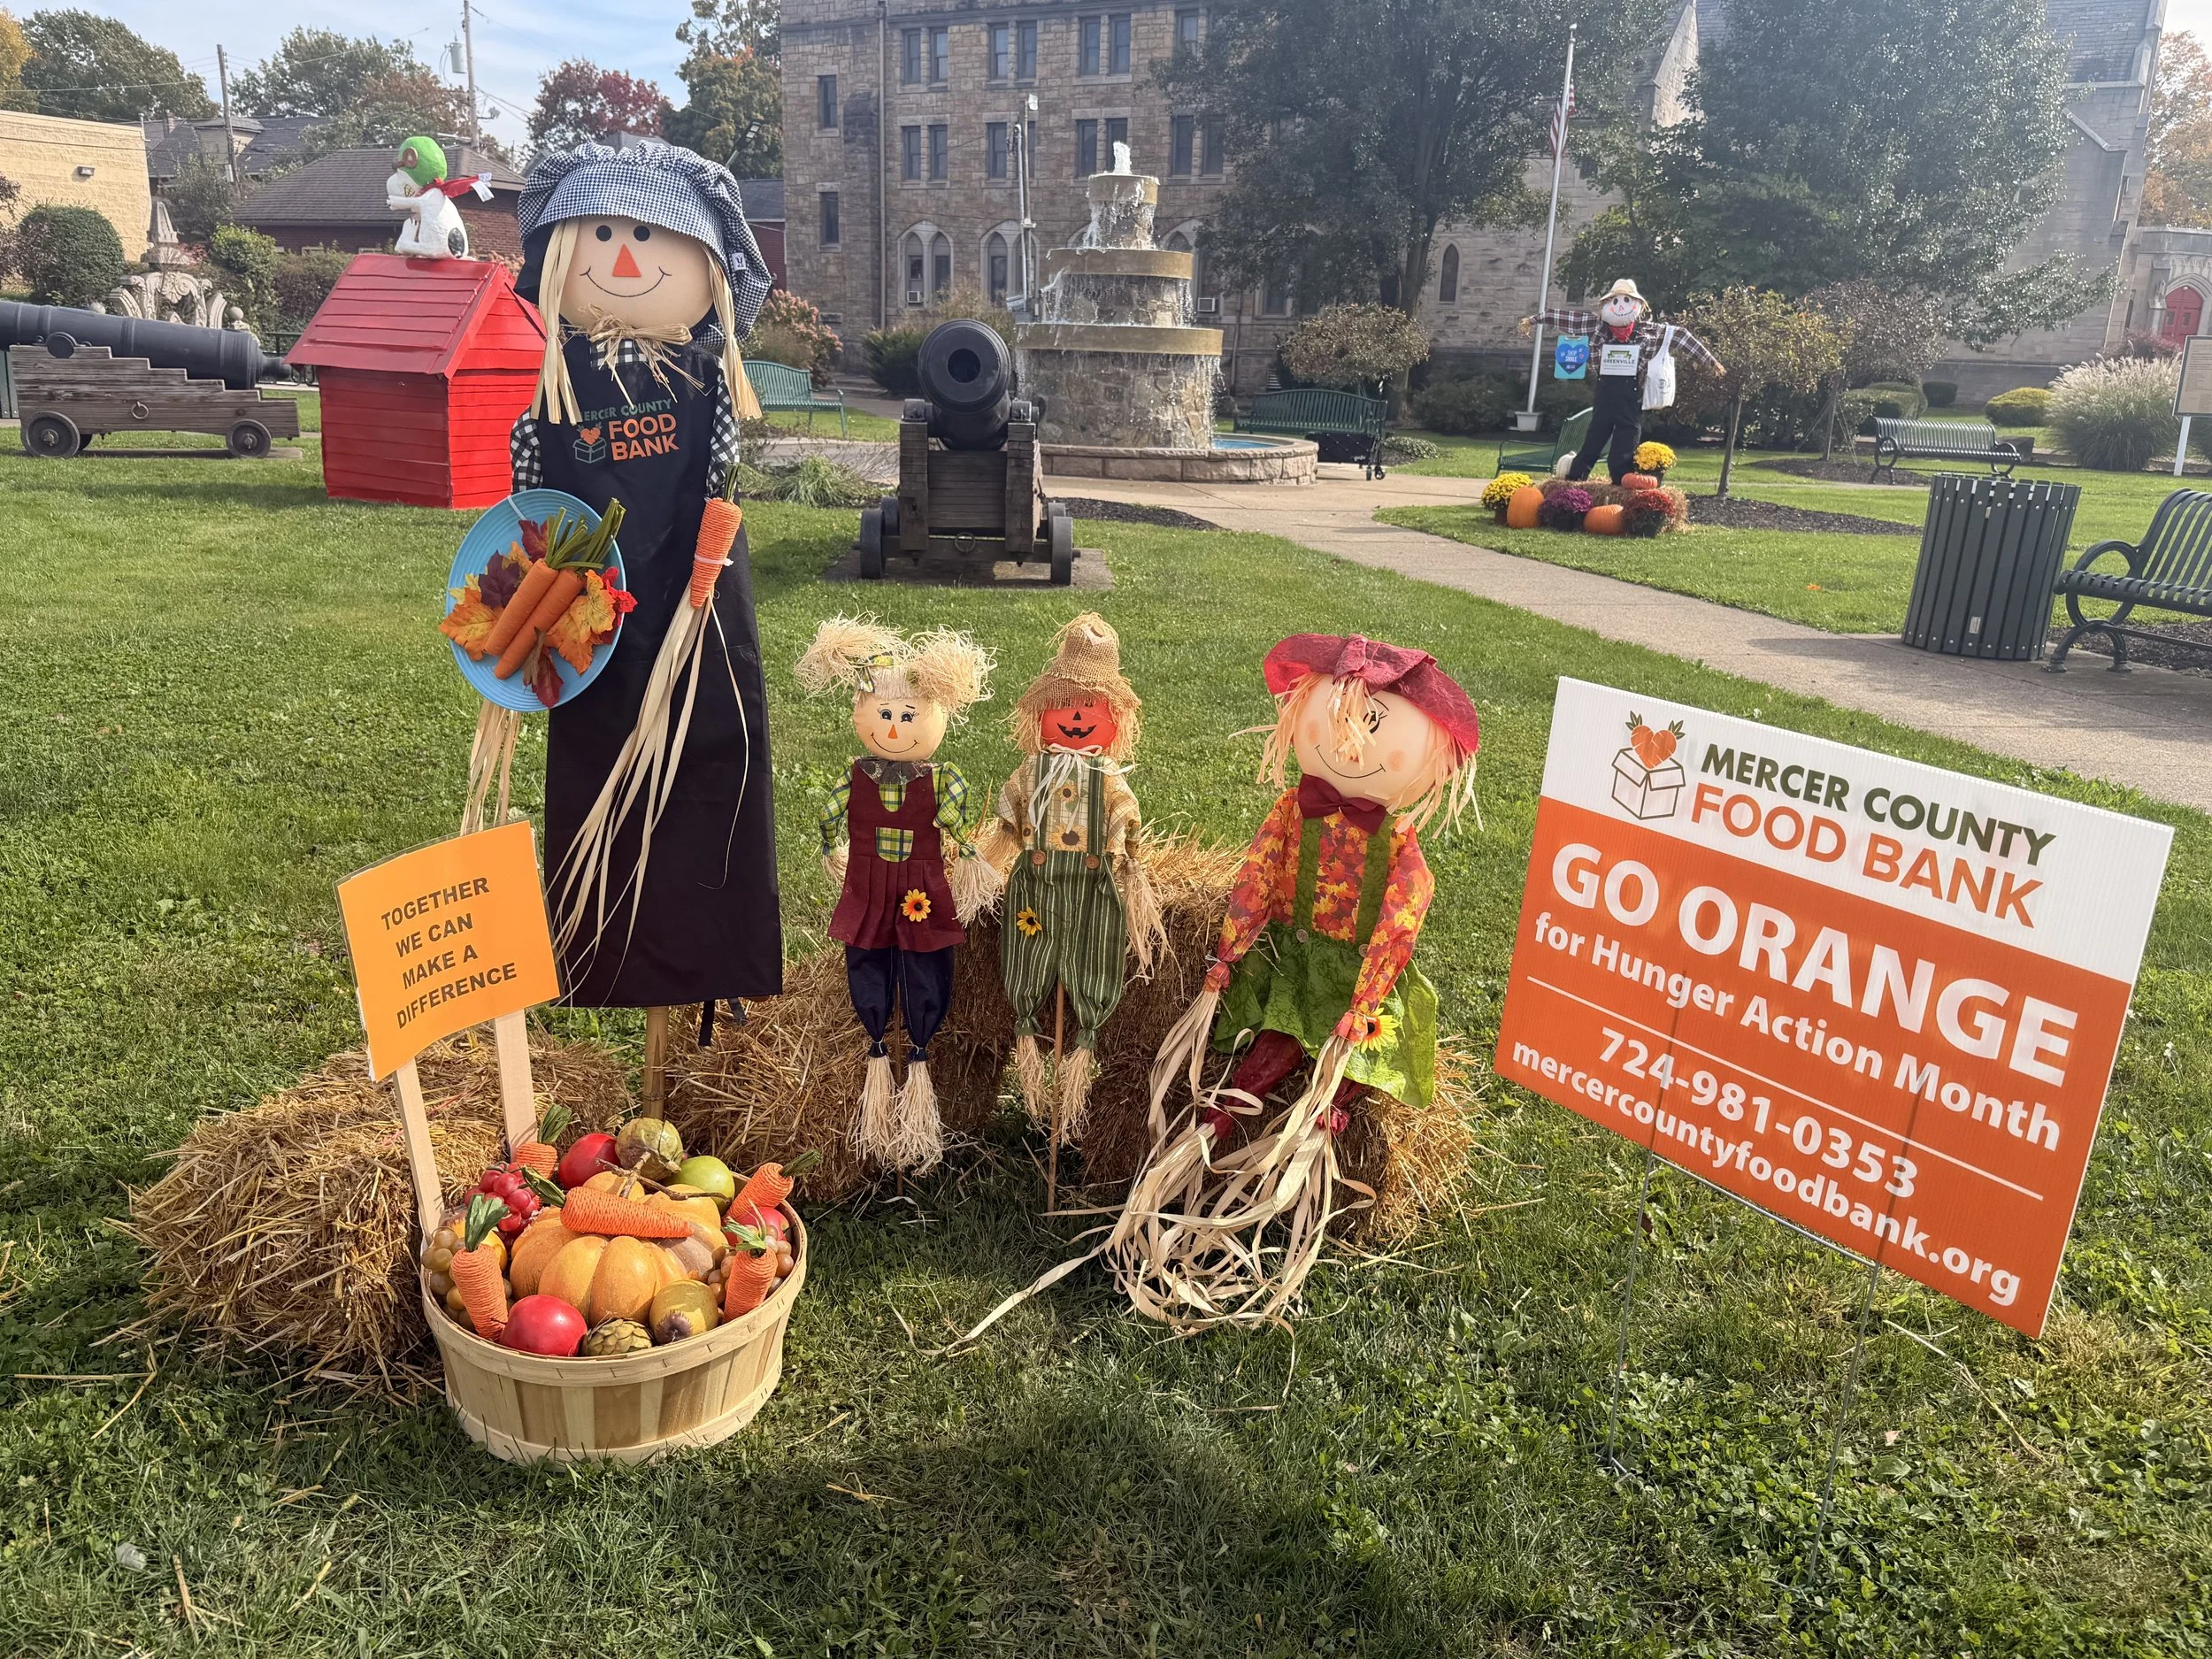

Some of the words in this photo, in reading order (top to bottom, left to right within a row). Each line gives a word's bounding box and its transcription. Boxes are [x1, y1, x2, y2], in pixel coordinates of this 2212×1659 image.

[582, 407, 617, 422] ERCER
[620, 398, 672, 416] COUNTY
[608, 413, 677, 440] FOOD
[611, 433, 680, 461] BANK
[1700, 743, 1850, 813] MERCER
[1863, 787, 2057, 866] COUNTY
[1691, 783, 1847, 863] FOOD
[1863, 833, 2043, 929] BANK
[380, 877, 490, 931] TOGETHER
[396, 931, 423, 958] WE
[428, 912, 473, 942] CAN
[396, 962, 518, 1030] DIFFERENCE
[402, 950, 456, 990] MAKE
[463, 944, 479, 964] A
[1552, 842, 1660, 926] GO
[1678, 886, 2078, 1087] ORANGE
[1535, 911, 1586, 956] for
[1591, 933, 1735, 1017] Hunger
[1740, 995, 1883, 1079] Action
[1893, 1053, 2061, 1152] Month
[1601, 1026, 1918, 1198] 724-981-0353
[1512, 1041, 2021, 1307] mercercountyfoodbank.org
